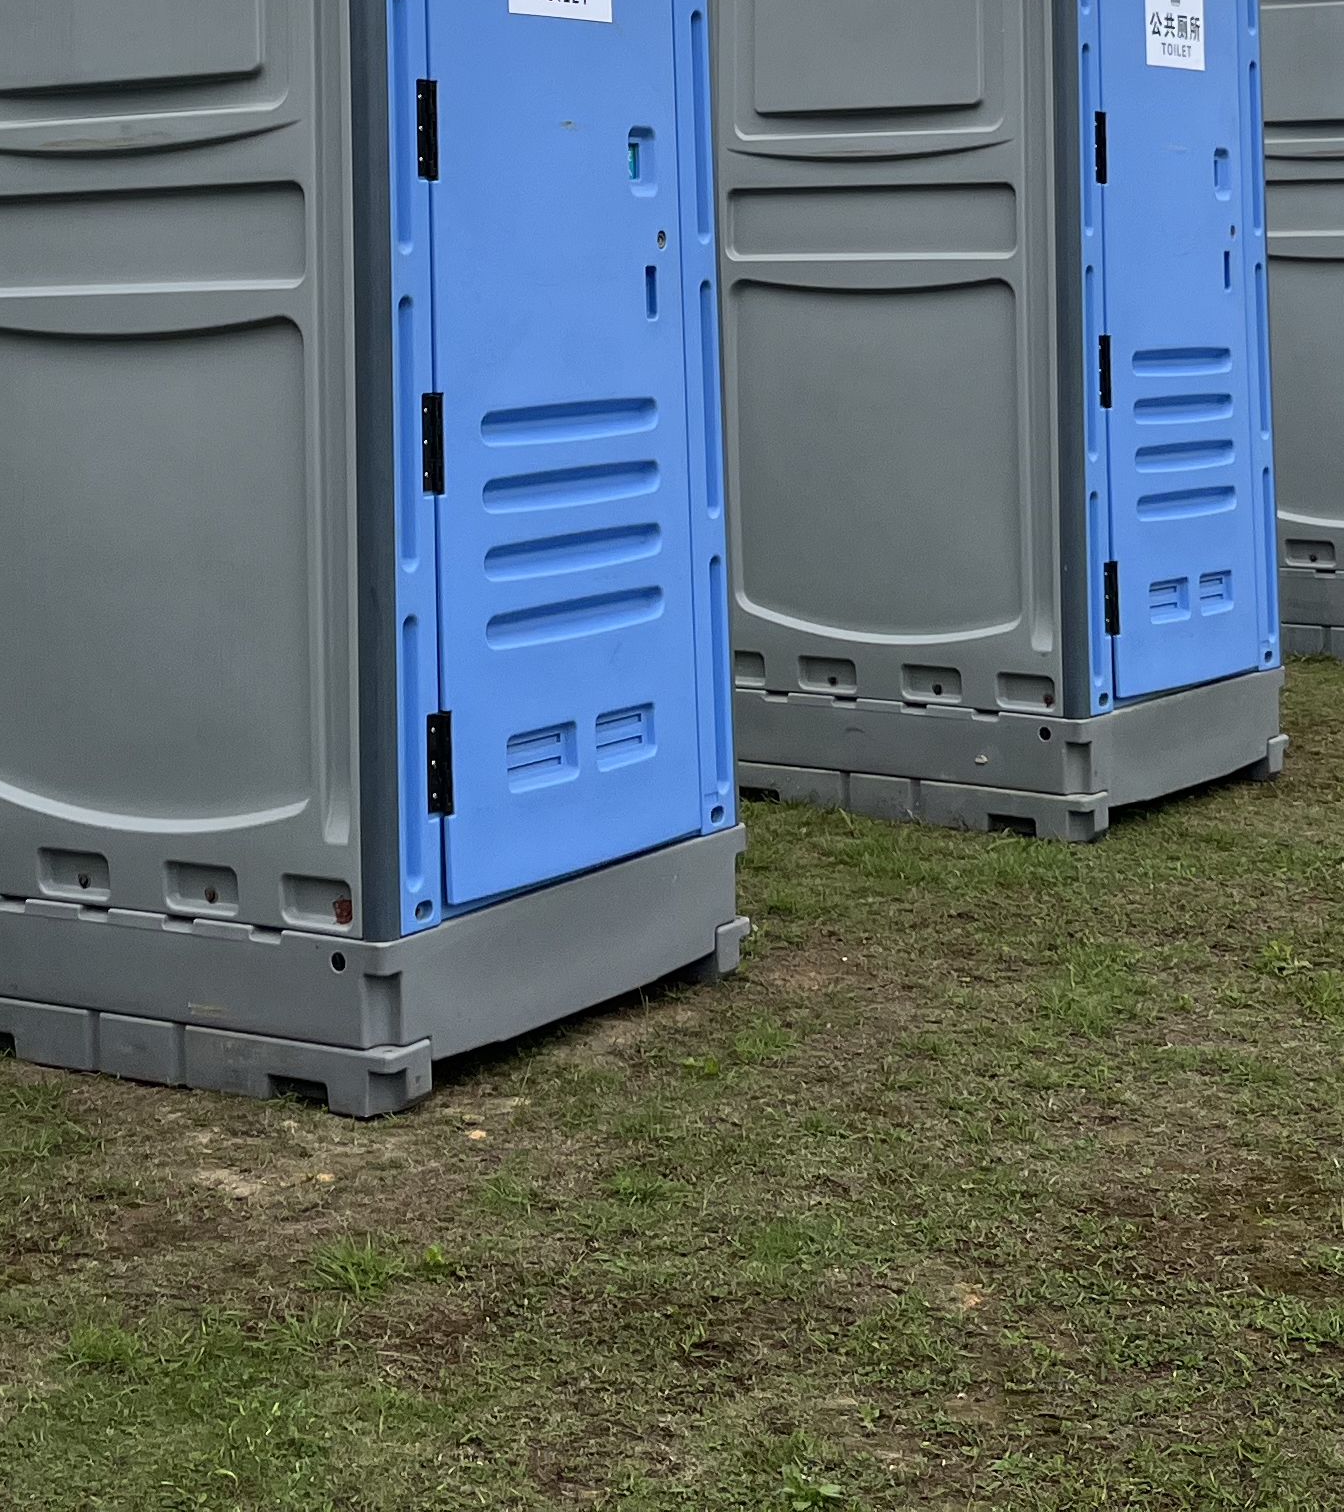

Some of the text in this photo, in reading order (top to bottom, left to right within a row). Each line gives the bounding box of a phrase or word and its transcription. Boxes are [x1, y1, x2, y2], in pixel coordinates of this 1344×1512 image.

[1149, 11, 1201, 42] 公共厕所
[1161, 42, 1192, 58] TOILET
